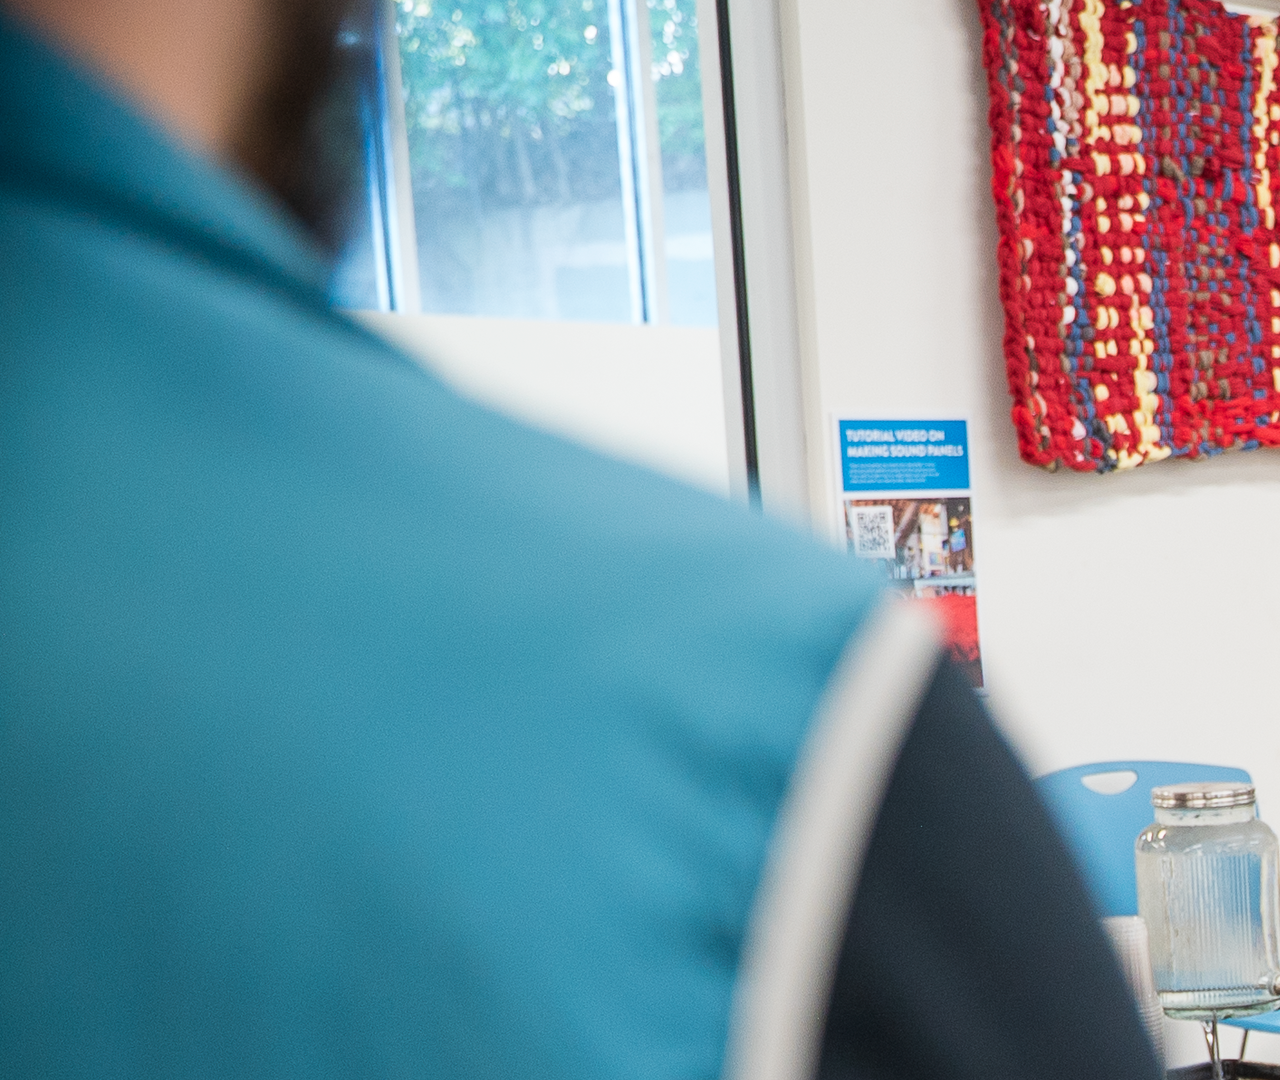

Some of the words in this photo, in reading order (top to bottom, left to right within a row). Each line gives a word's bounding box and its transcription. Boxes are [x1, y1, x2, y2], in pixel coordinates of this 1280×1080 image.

[846, 429, 895, 442] TUTORIAL
[894, 429, 928, 442] VIDEO
[928, 430, 945, 442] ON
[847, 444, 890, 457] MAKING
[890, 444, 927, 457] SOUND
[928, 444, 964, 457] PANELS
